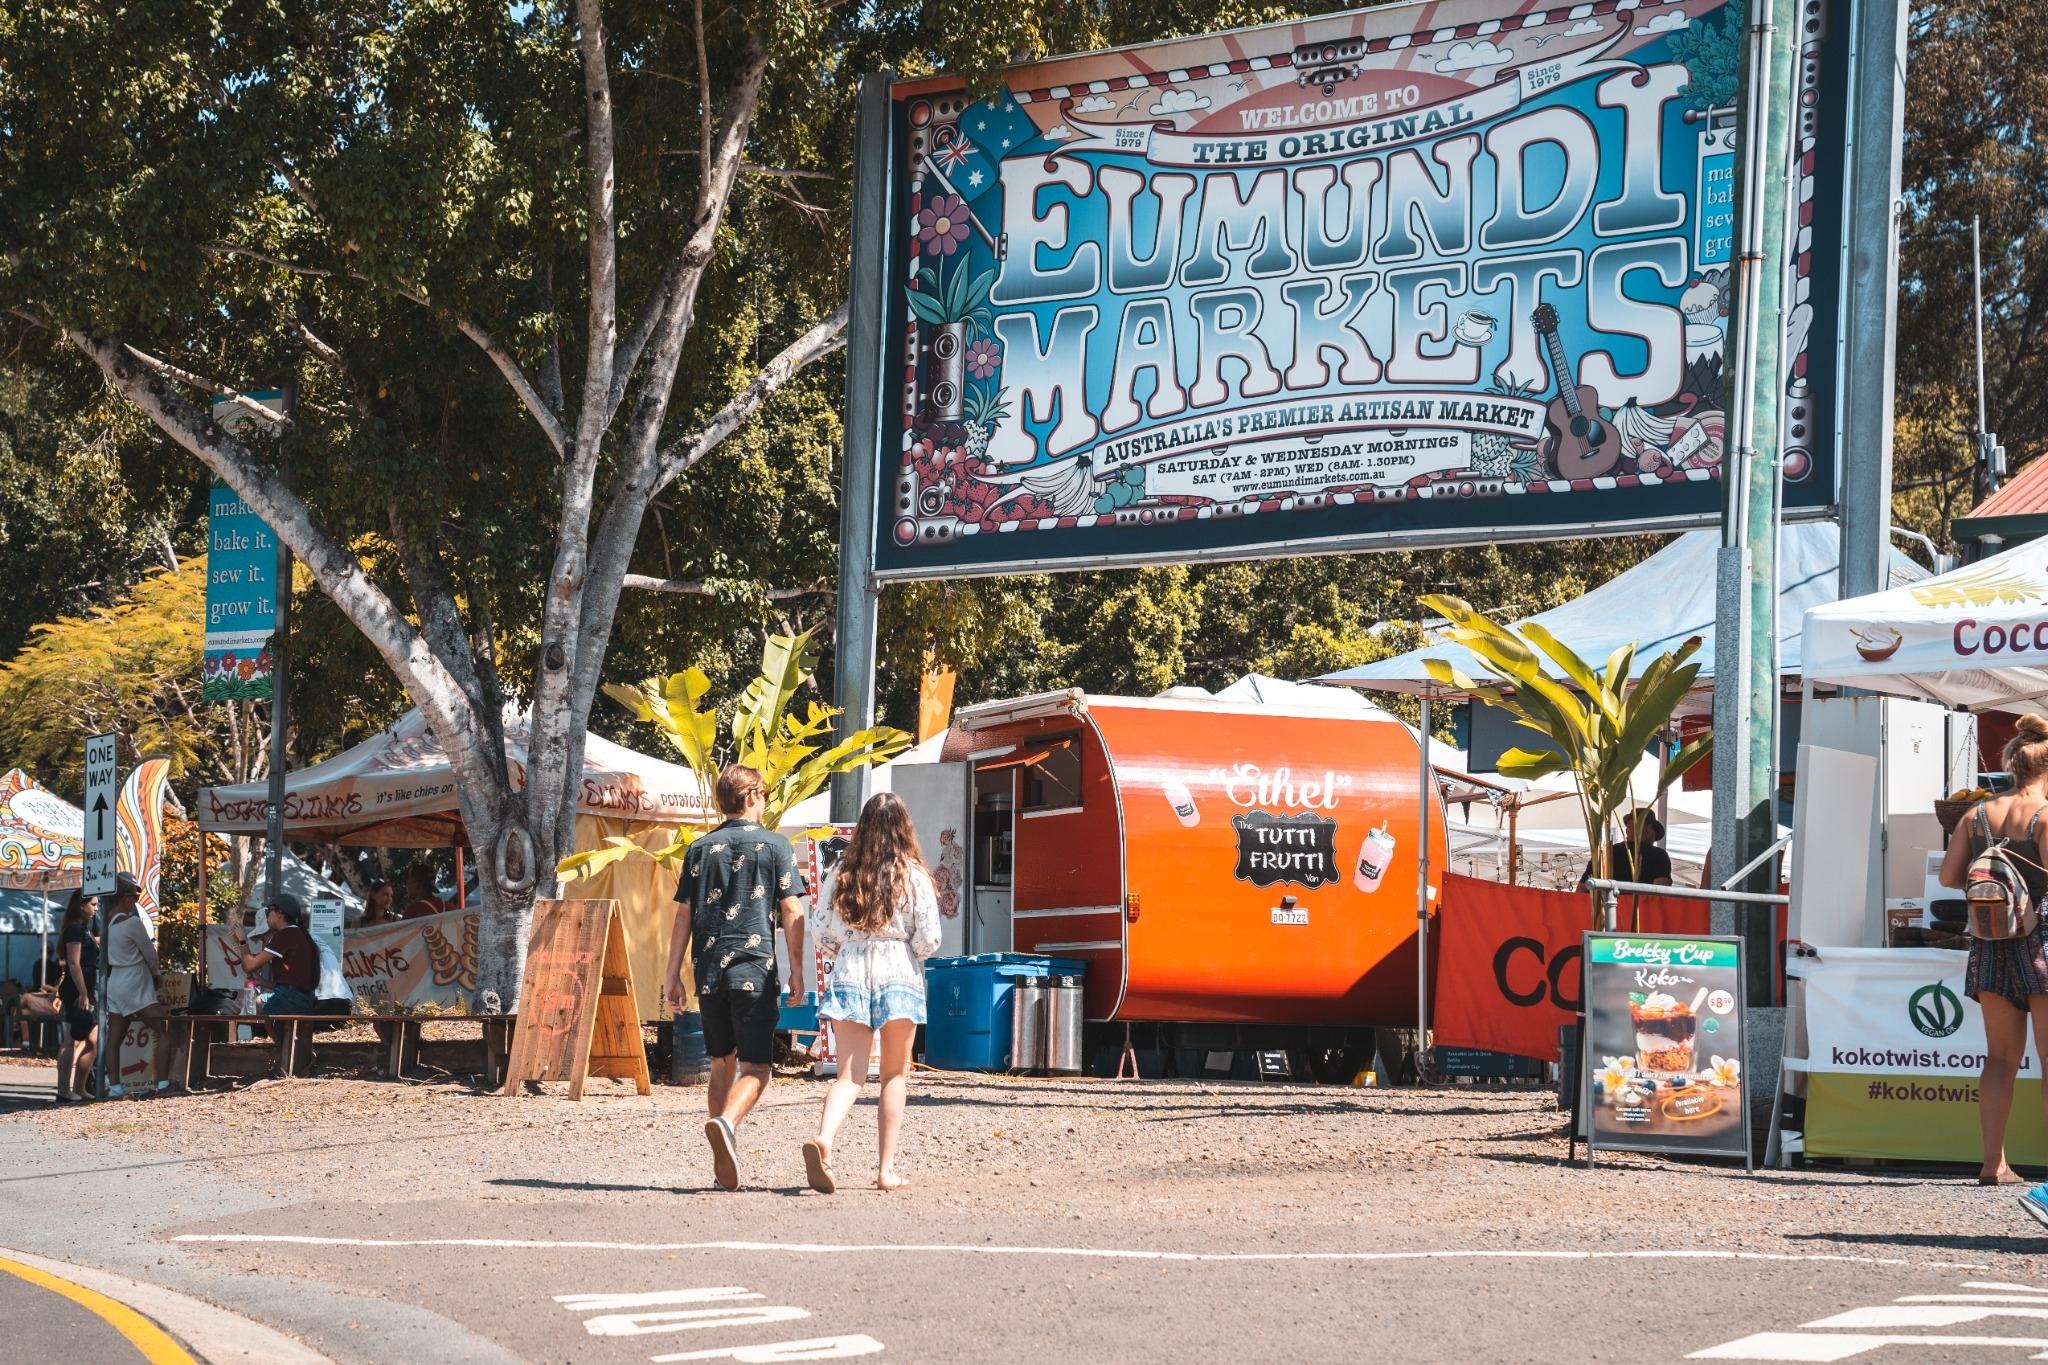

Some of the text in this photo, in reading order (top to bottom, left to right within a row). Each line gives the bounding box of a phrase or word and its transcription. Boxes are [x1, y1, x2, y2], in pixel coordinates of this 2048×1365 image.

[1527, 62, 1562, 80] Since
[1530, 72, 1561, 90] 1979
[1239, 84, 1420, 130] WELCOME TO
[1115, 128, 1145, 138] Since
[1115, 138, 1142, 147] 1979
[1192, 102, 1474, 163] THE ORIGINAL
[990, 62, 1691, 305] EUMUNDI
[986, 236, 1688, 466] MARKETS
[1104, 400, 1535, 465] AUSTRALIA'S PREMIER ARTISAN MARKET
[1157, 435, 1459, 474] SATURDAY & WEDNESDAY MORNINGS
[1192, 474, 1217, 485] SAT
[1220, 471, 1252, 484] (7AM
[1260, 466, 1291, 480] 2PM)
[1294, 463, 1324, 475] WED
[1367, 455, 1416, 468] 1.30PM)
[1233, 470, 1386, 493] www.eumundimarkets.com.au
[214, 529, 272, 551] bake it.
[212, 564, 265, 584] sew it.
[211, 596, 274, 624] grow it.
[89, 745, 113, 764] ONE
[89, 768, 113, 787] WAY
[377, 783, 454, 804] it's like chips on
[583, 778, 655, 814] SLINKYS
[283, 791, 363, 819] SLINKYS
[1239, 820, 1253, 829] The
[1255, 827, 1315, 847] TUTTI
[86, 848, 114, 861] WED & SAT
[1249, 851, 1324, 871] FRUTTI
[1305, 873, 1319, 882] Van
[1612, 939, 1714, 964] Brekky Cup
[1634, 968, 1680, 988] Koko
[125, 1026, 149, 1048] $6
[1920, 1025, 1957, 1037] VEGAN OK
[1675, 1095, 1705, 1107] Available
[1868, 1081, 1980, 1103] #kokotwis
[1684, 1107, 1700, 1115] here
